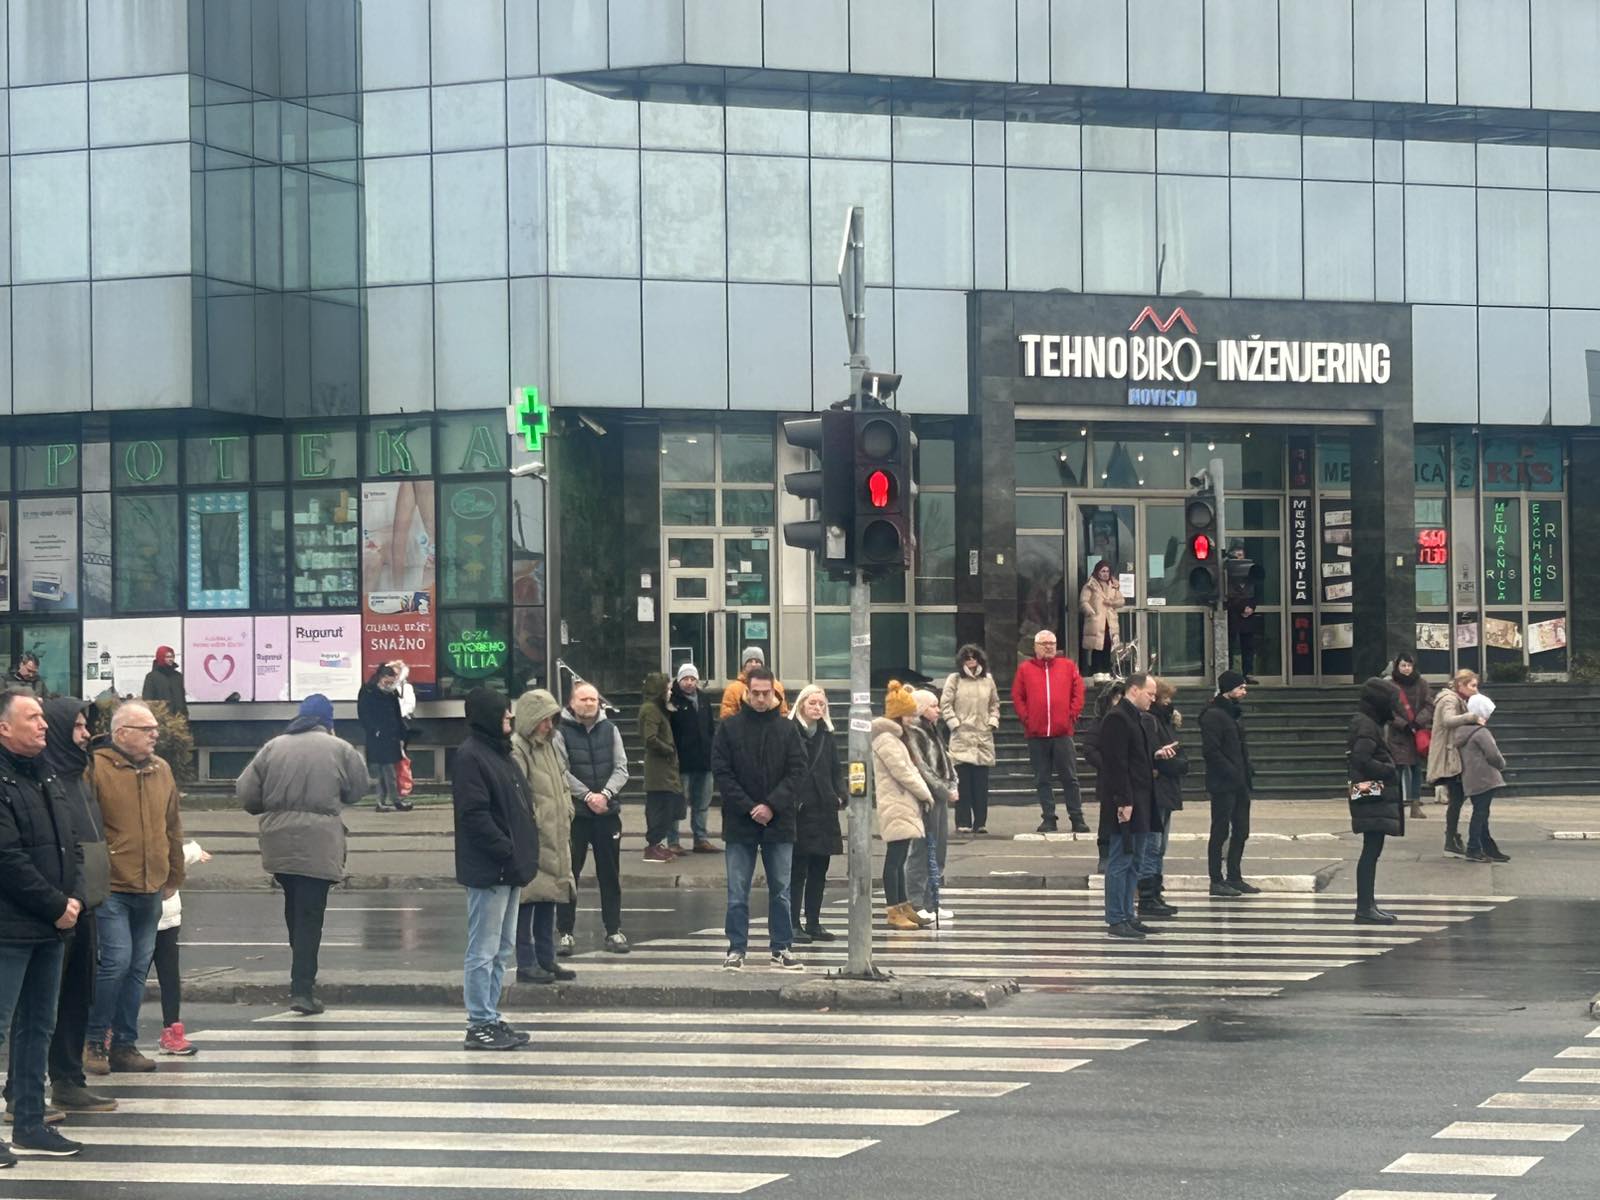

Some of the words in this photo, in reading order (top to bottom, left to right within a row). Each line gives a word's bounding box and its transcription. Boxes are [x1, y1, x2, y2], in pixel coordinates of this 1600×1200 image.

[1487, 462, 1553, 485] RIS
[1532, 504, 1542, 600] EXCHANGE
[1544, 523, 1556, 580] RIS
[296, 626, 344, 641] Rupurut
[371, 634, 426, 651] SNAŽNO
[453, 653, 499, 669] TILIA
